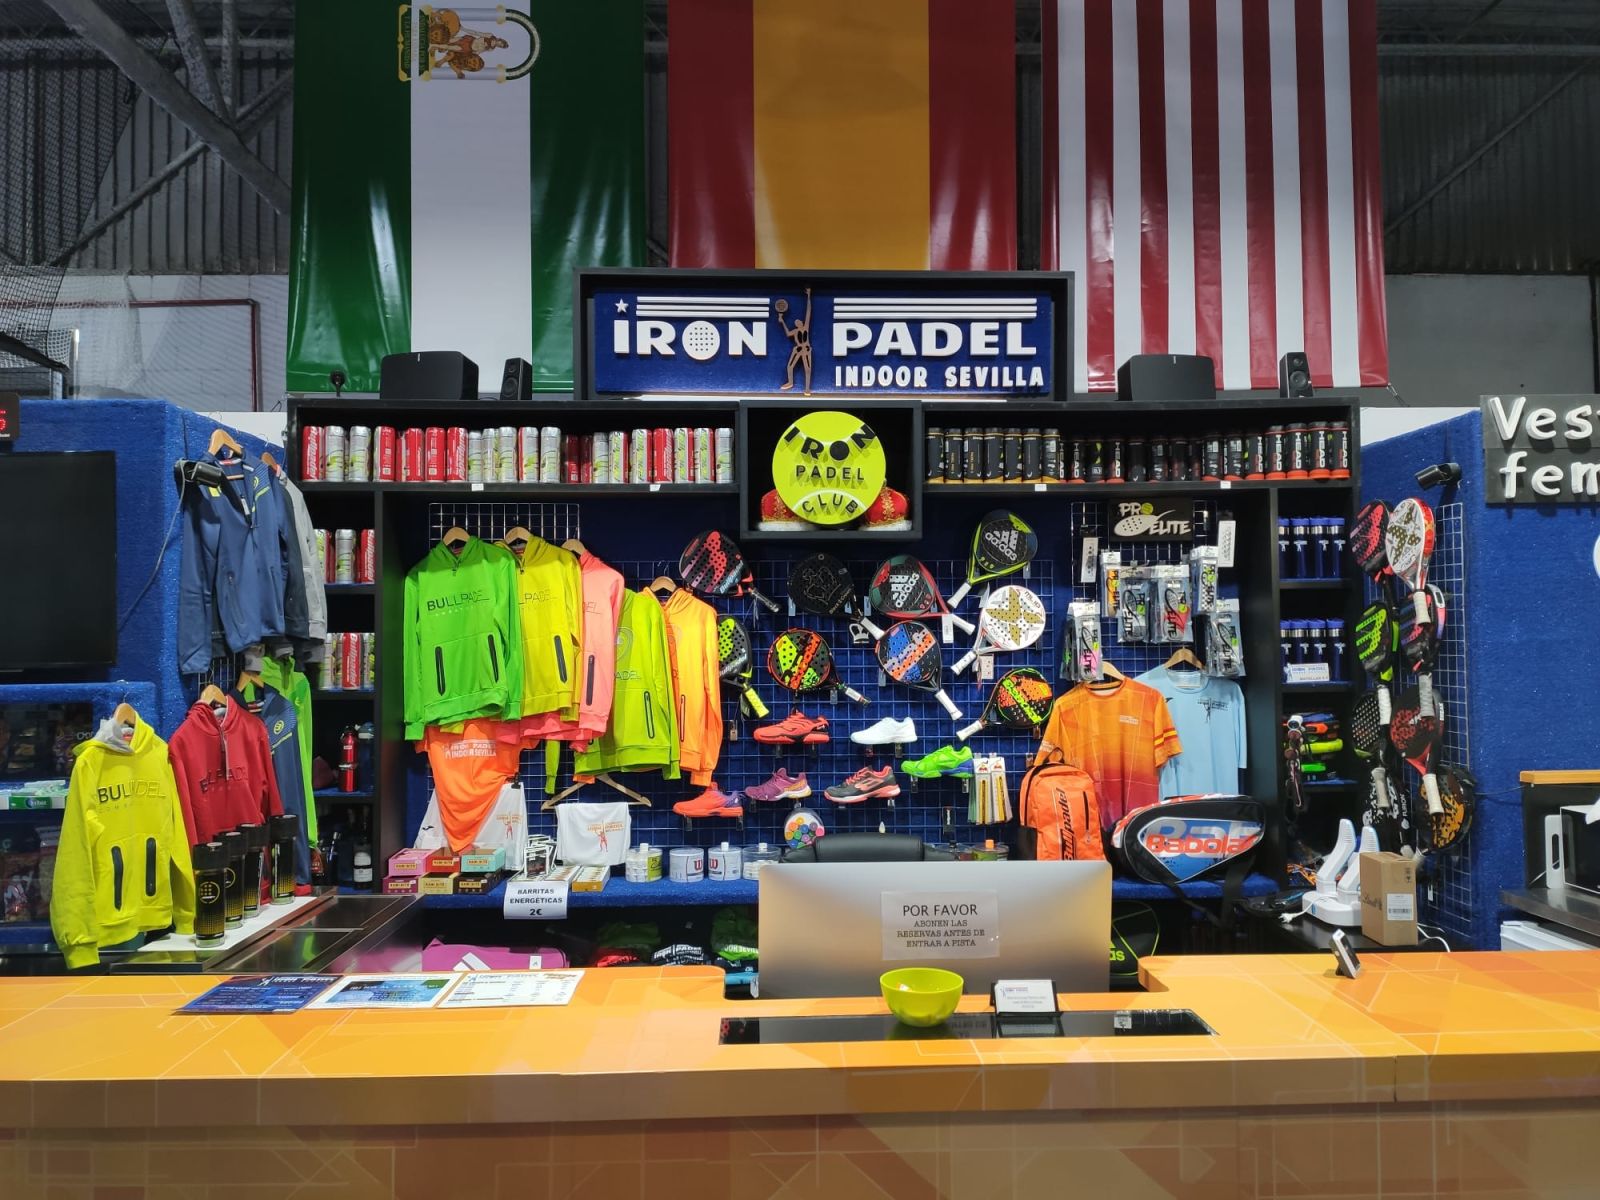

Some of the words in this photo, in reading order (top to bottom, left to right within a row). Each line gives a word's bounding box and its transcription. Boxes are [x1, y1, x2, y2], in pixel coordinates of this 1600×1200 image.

[613, 320, 767, 360] IRON
[833, 322, 1037, 357] PADEL
[834, 365, 928, 387] INDOOR
[945, 365, 1044, 388] SEVILLA
[1488, 396, 1600, 440] Ves
[784, 424, 877, 459] IRON
[1256, 436, 1264, 473] HEAD
[1275, 434, 1283, 471] HEAD
[1318, 430, 1326, 468] HEAD
[1341, 430, 1349, 468] HEAD
[796, 465, 865, 481] PADEL
[802, 493, 858, 514] CLUB
[1149, 520, 1191, 535] ELITE
[985, 532, 1018, 561] adidas
[895, 572, 920, 608] adidas
[529, 908, 542, 916] 2€
[903, 904, 930, 917] POR
[934, 903, 978, 916] FAVOR
[897, 929, 942, 938] RESERVAS
[943, 929, 972, 937] ANTES
[973, 929, 985, 937] DE
[913, 920, 949, 928] ABONEN
[951, 919, 968, 927] LAS
[906, 939, 942, 948] ENTRAR
[943, 939, 950, 947] A
[951, 939, 976, 947] PISTA
